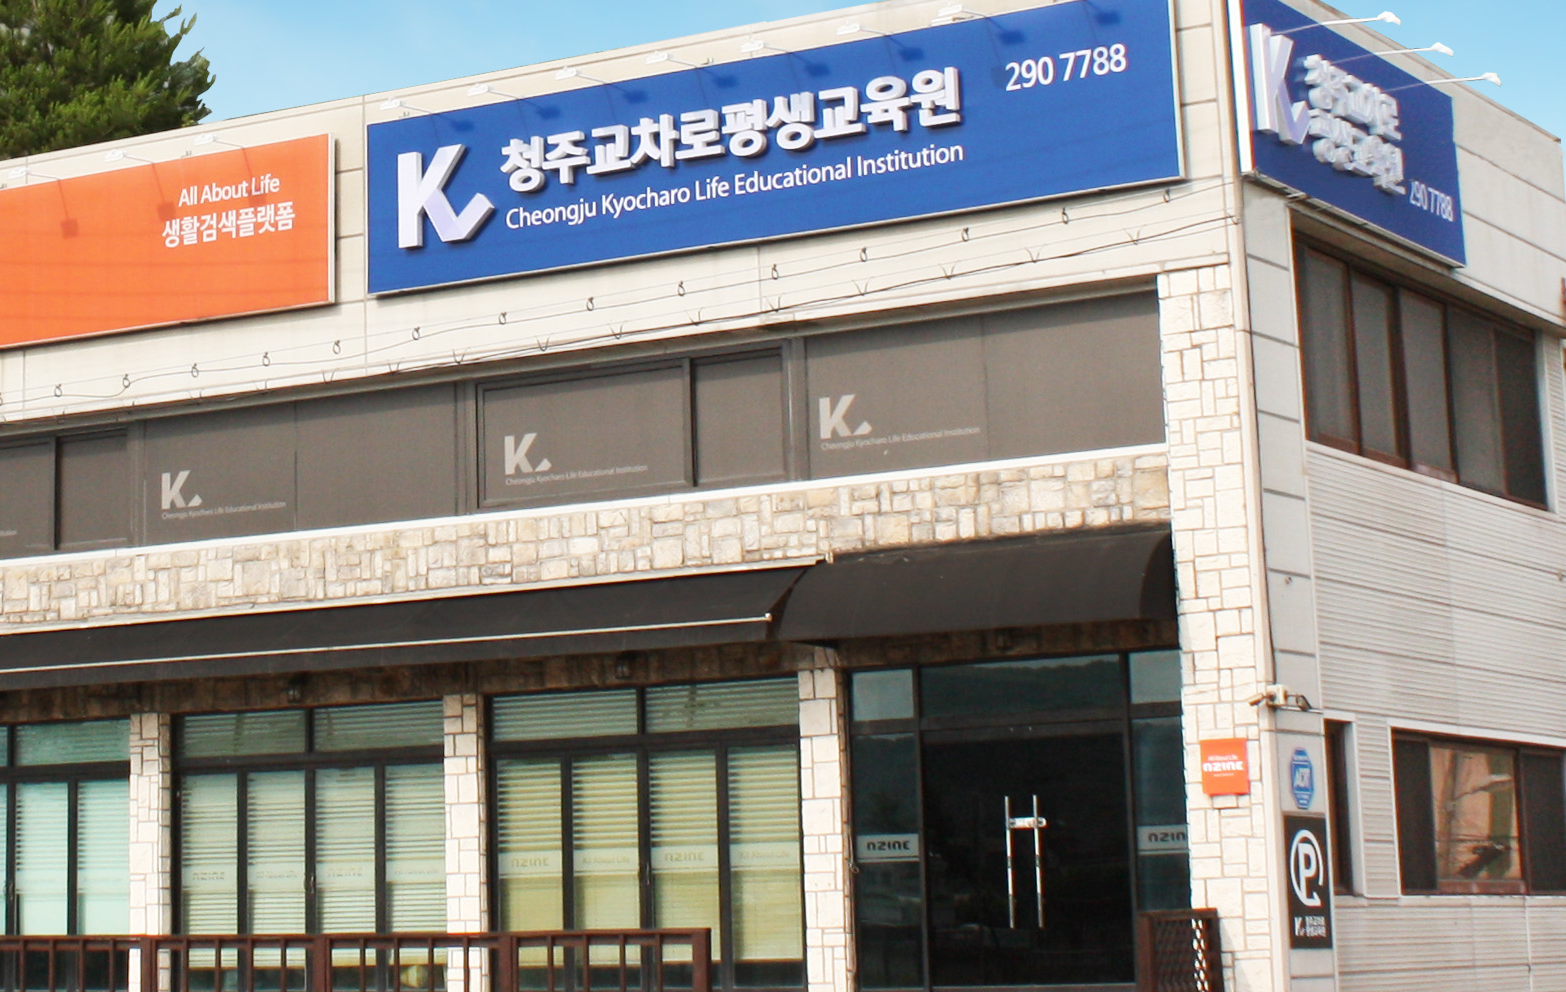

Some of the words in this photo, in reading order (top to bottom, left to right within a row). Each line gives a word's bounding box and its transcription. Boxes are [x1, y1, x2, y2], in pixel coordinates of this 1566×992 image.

[1005, 57, 1054, 91] 290
[1059, 43, 1127, 81] 7788
[500, 66, 961, 193] 청주교차로평생교육원
[178, 186, 198, 207] All
[200, 180, 249, 204] About
[251, 173, 281, 195] Life
[397, 144, 495, 250] K
[505, 199, 597, 229] Cheongju
[601, 186, 691, 219] Kyocharo
[695, 175, 730, 201] Life
[734, 157, 852, 195] Educational
[857, 143, 964, 177] Institution
[1409, 179, 1428, 210] 290
[162, 201, 295, 248] 생활검색플랫폼
